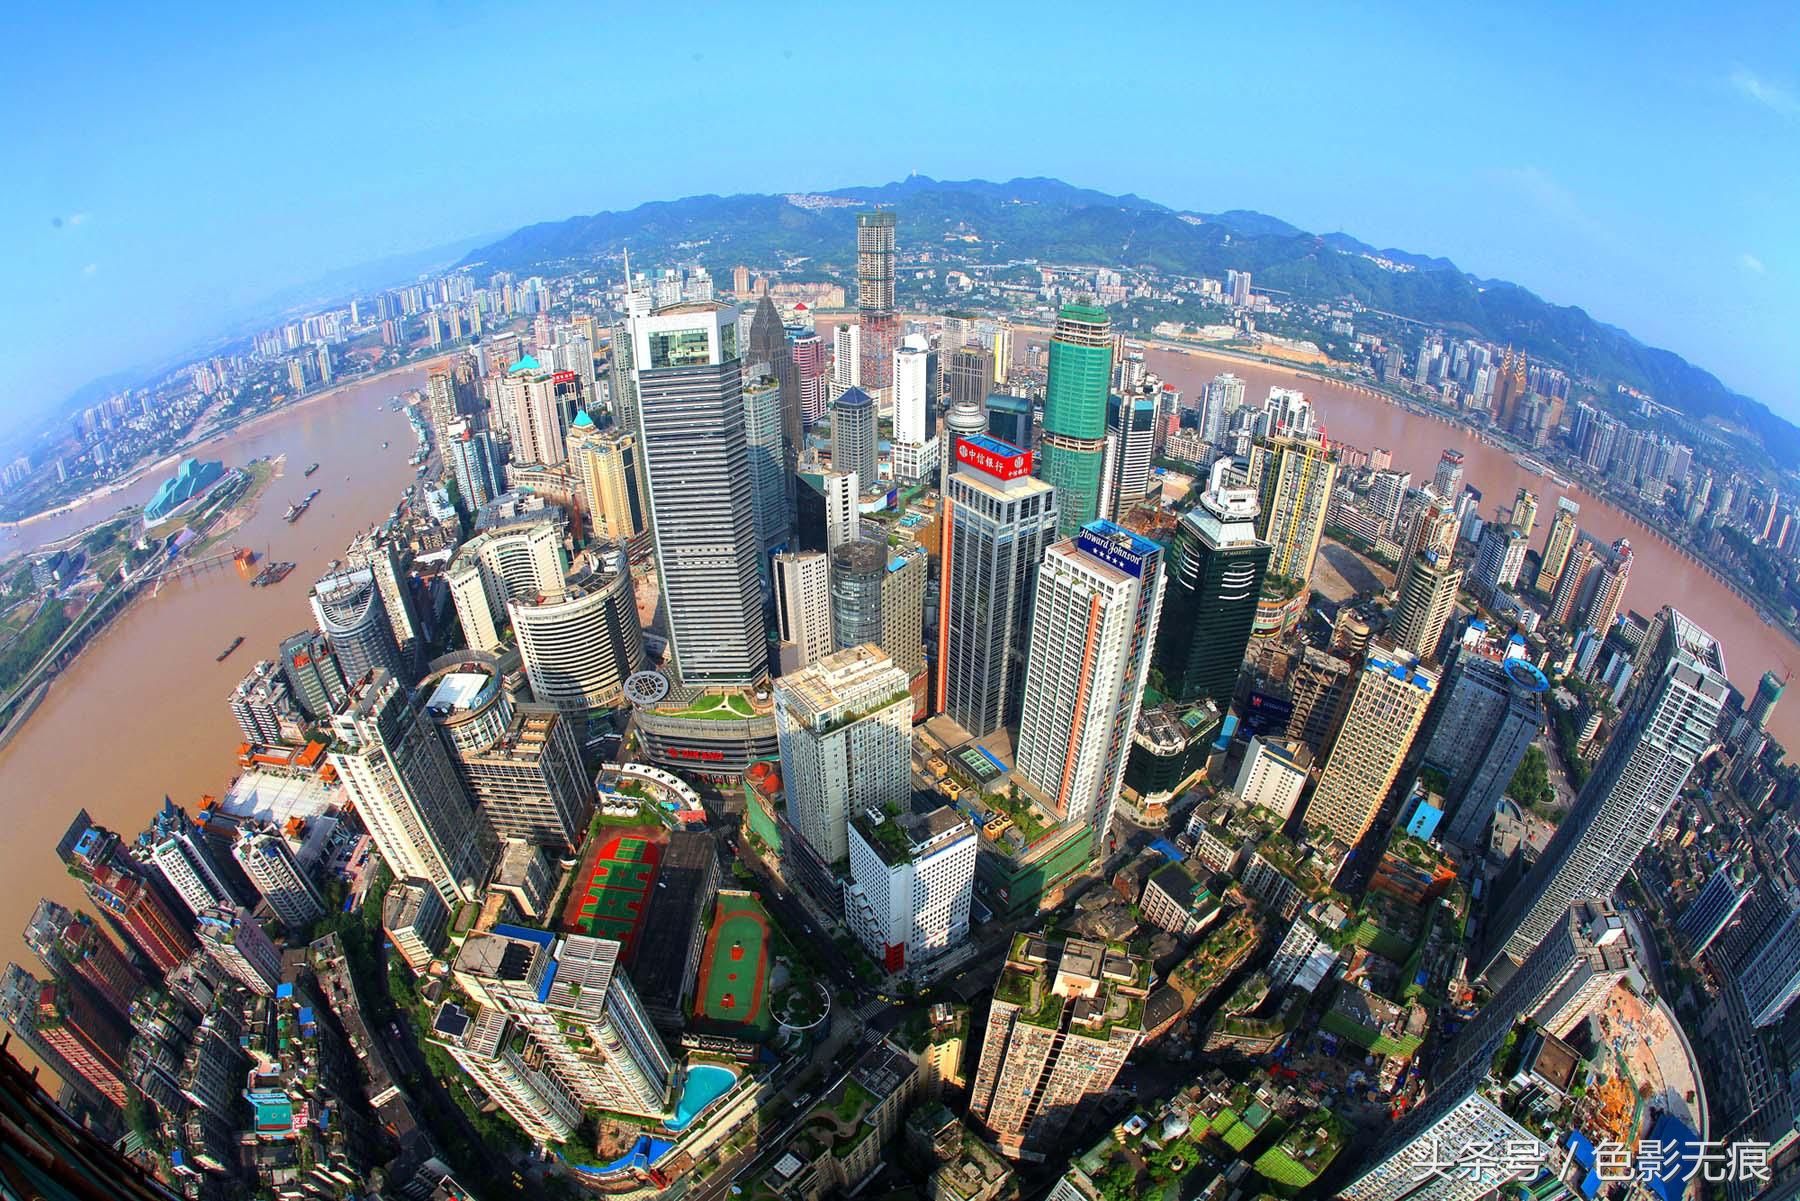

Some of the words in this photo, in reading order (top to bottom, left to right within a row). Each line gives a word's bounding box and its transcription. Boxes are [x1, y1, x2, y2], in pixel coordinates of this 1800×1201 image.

[969, 449, 1004, 473] 中信银行
[1079, 529, 1109, 549] Howard
[1108, 542, 1141, 565] Johnson
